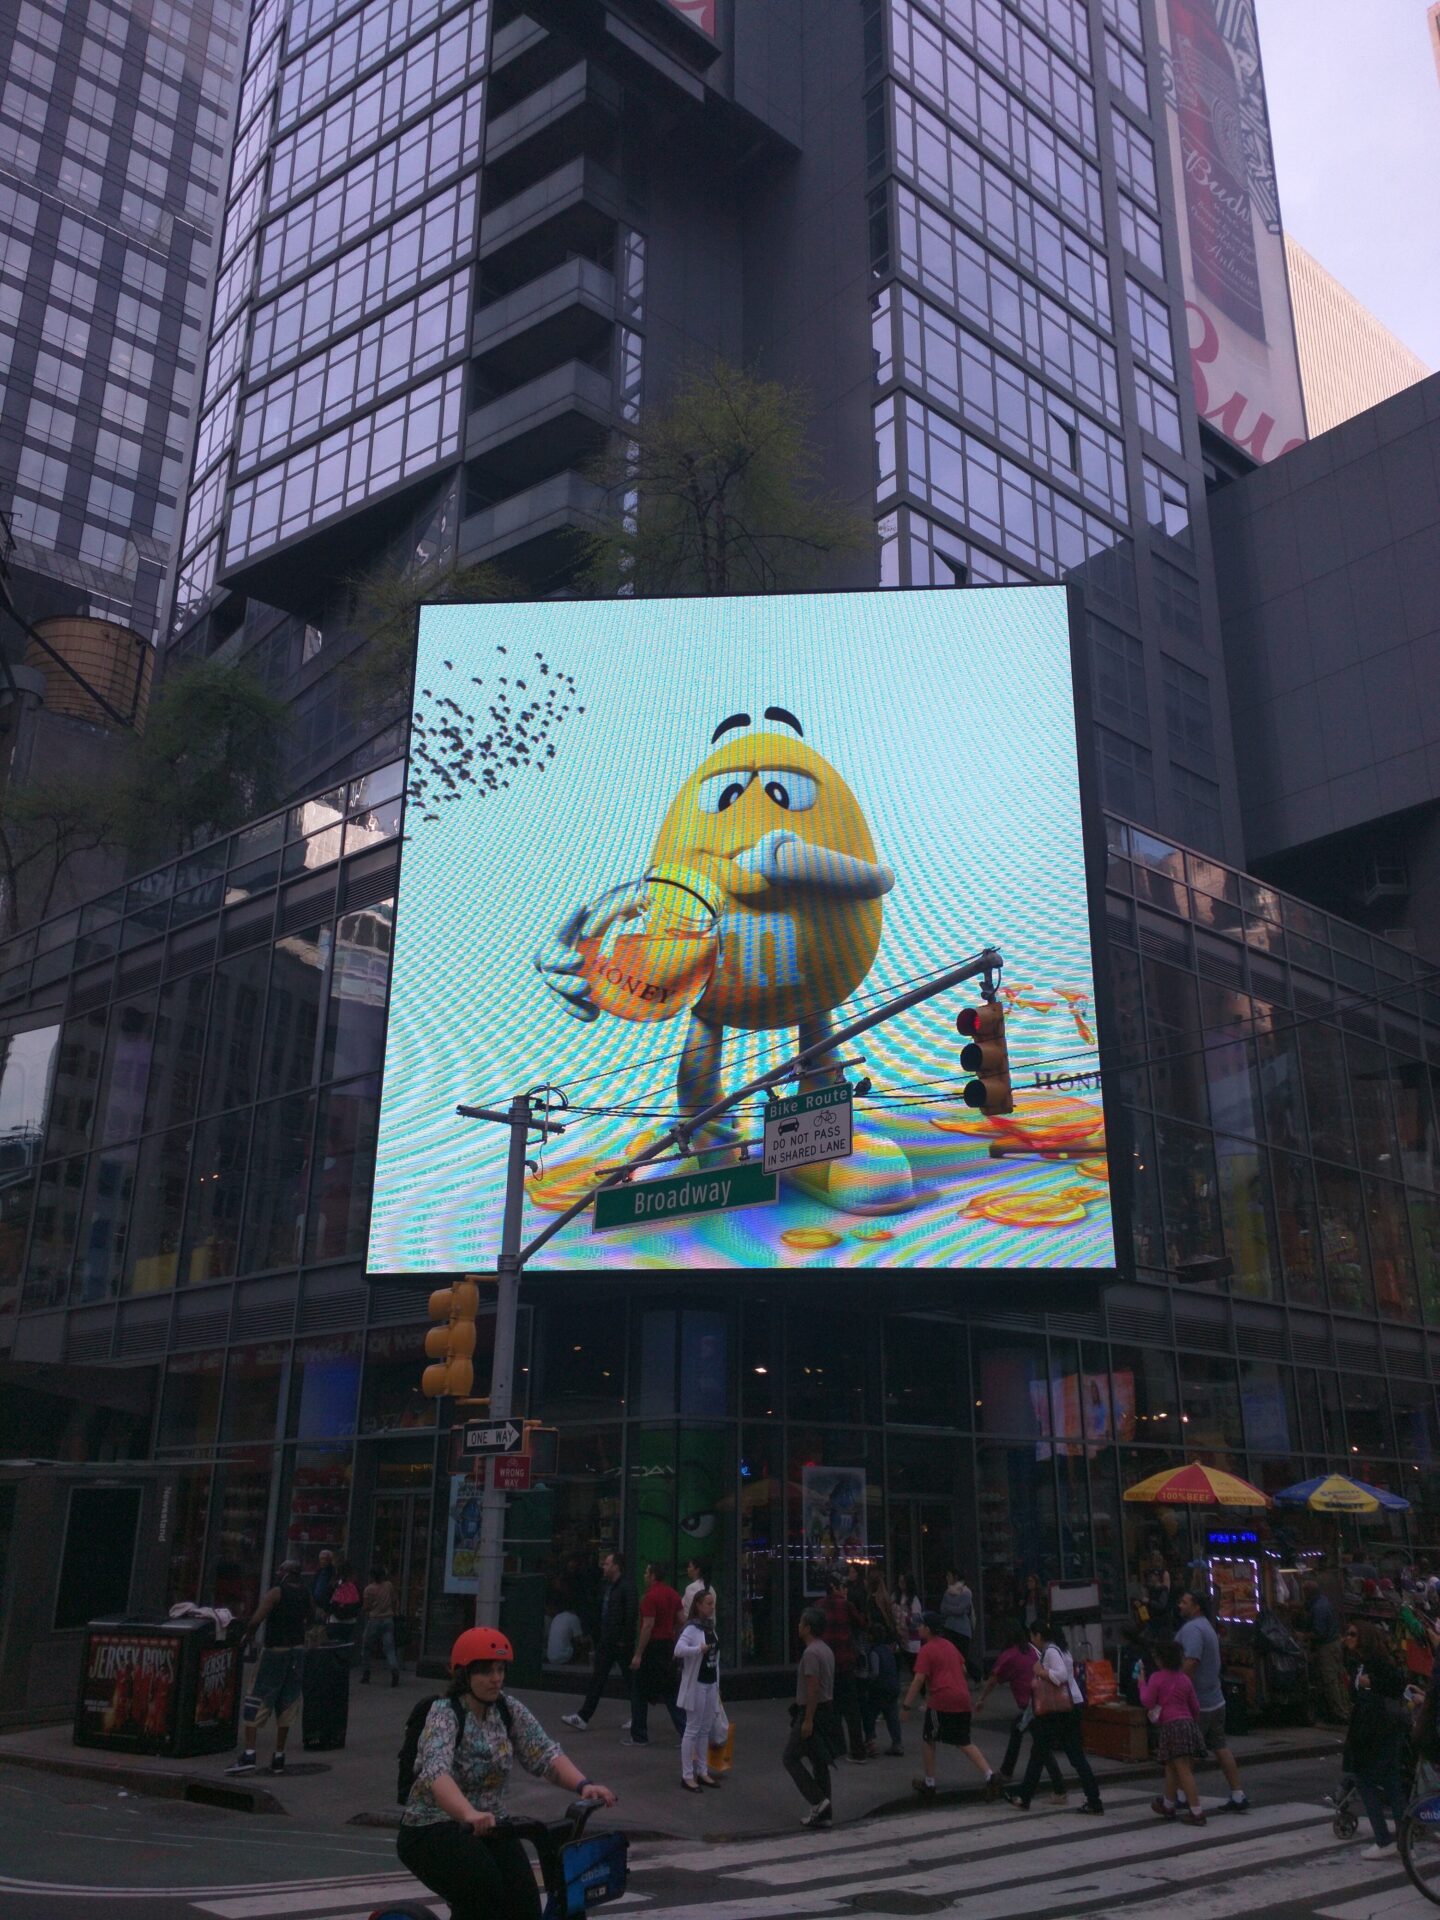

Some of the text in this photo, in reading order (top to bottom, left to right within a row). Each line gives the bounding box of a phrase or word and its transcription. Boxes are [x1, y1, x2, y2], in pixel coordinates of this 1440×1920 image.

[770, 1089, 848, 1118] Bike Route
[768, 1138, 846, 1166] IN SHARED LANE
[773, 1126, 841, 1151] DO NOT PASS
[634, 1179, 732, 1214] Broadway
[471, 1430, 514, 1445] ONE WAY
[500, 1468, 525, 1477] WRONG
[504, 1479, 519, 1488] WAY
[158, 1485, 173, 1543] Newsstand
[89, 1646, 175, 1684] JERSEY BOYS
[201, 1651, 233, 1677] JERSEY
